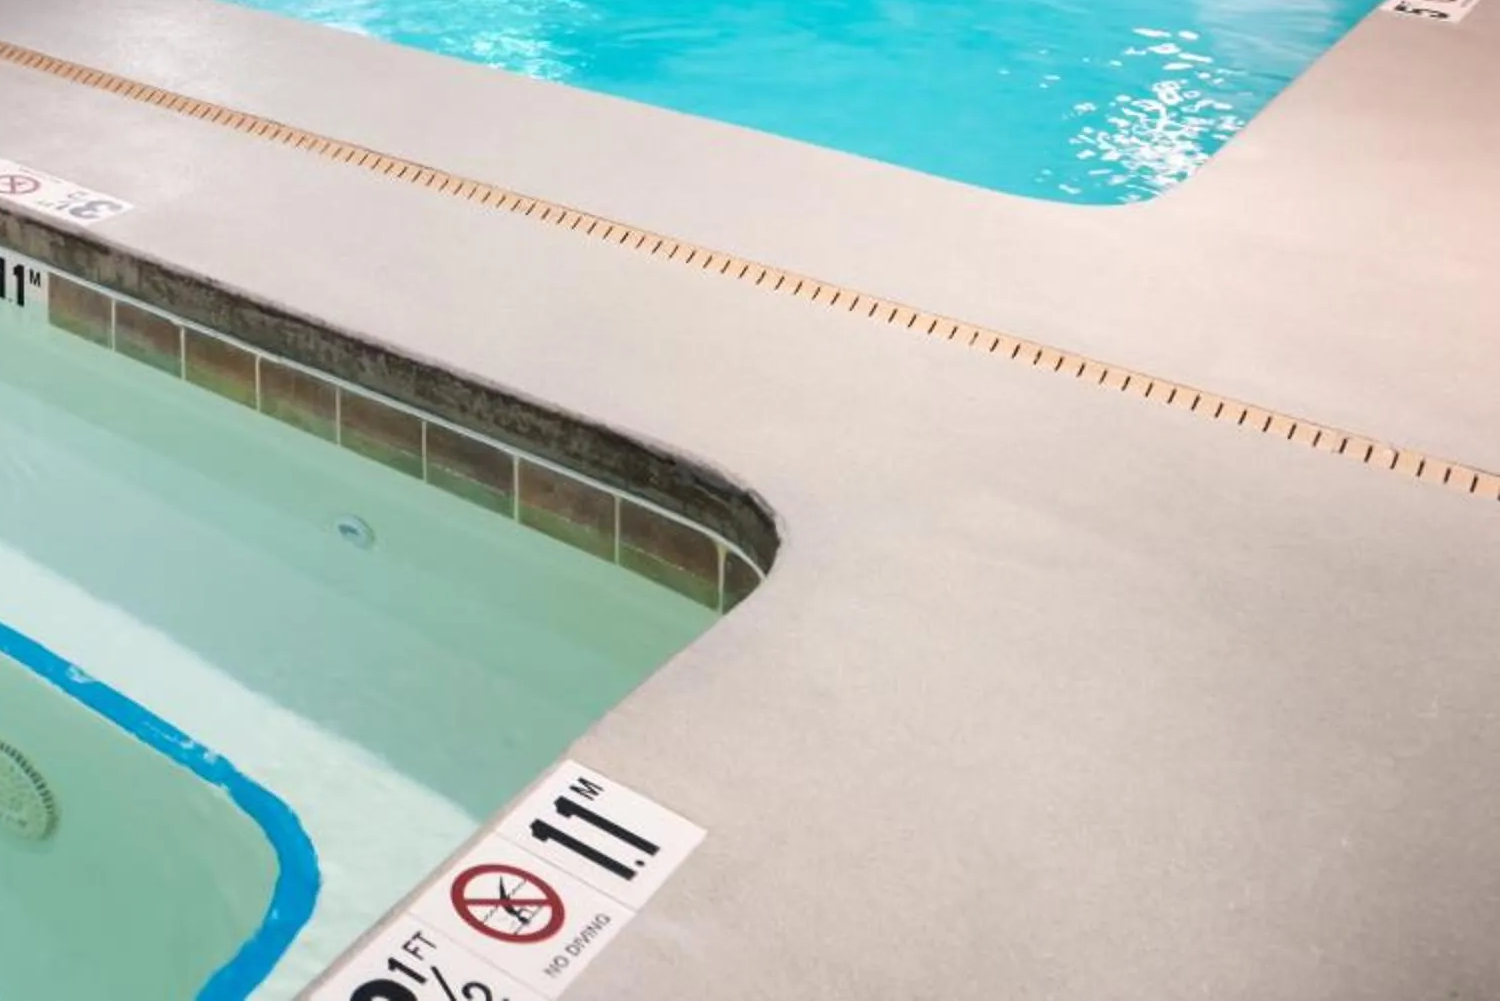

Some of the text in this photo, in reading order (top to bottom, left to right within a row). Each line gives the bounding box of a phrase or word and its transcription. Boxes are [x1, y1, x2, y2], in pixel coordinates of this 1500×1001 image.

[29, 268, 42, 288] M
[569, 776, 605, 801] M
[401, 930, 438, 961] FT
[542, 913, 612, 979] NO DIVING
